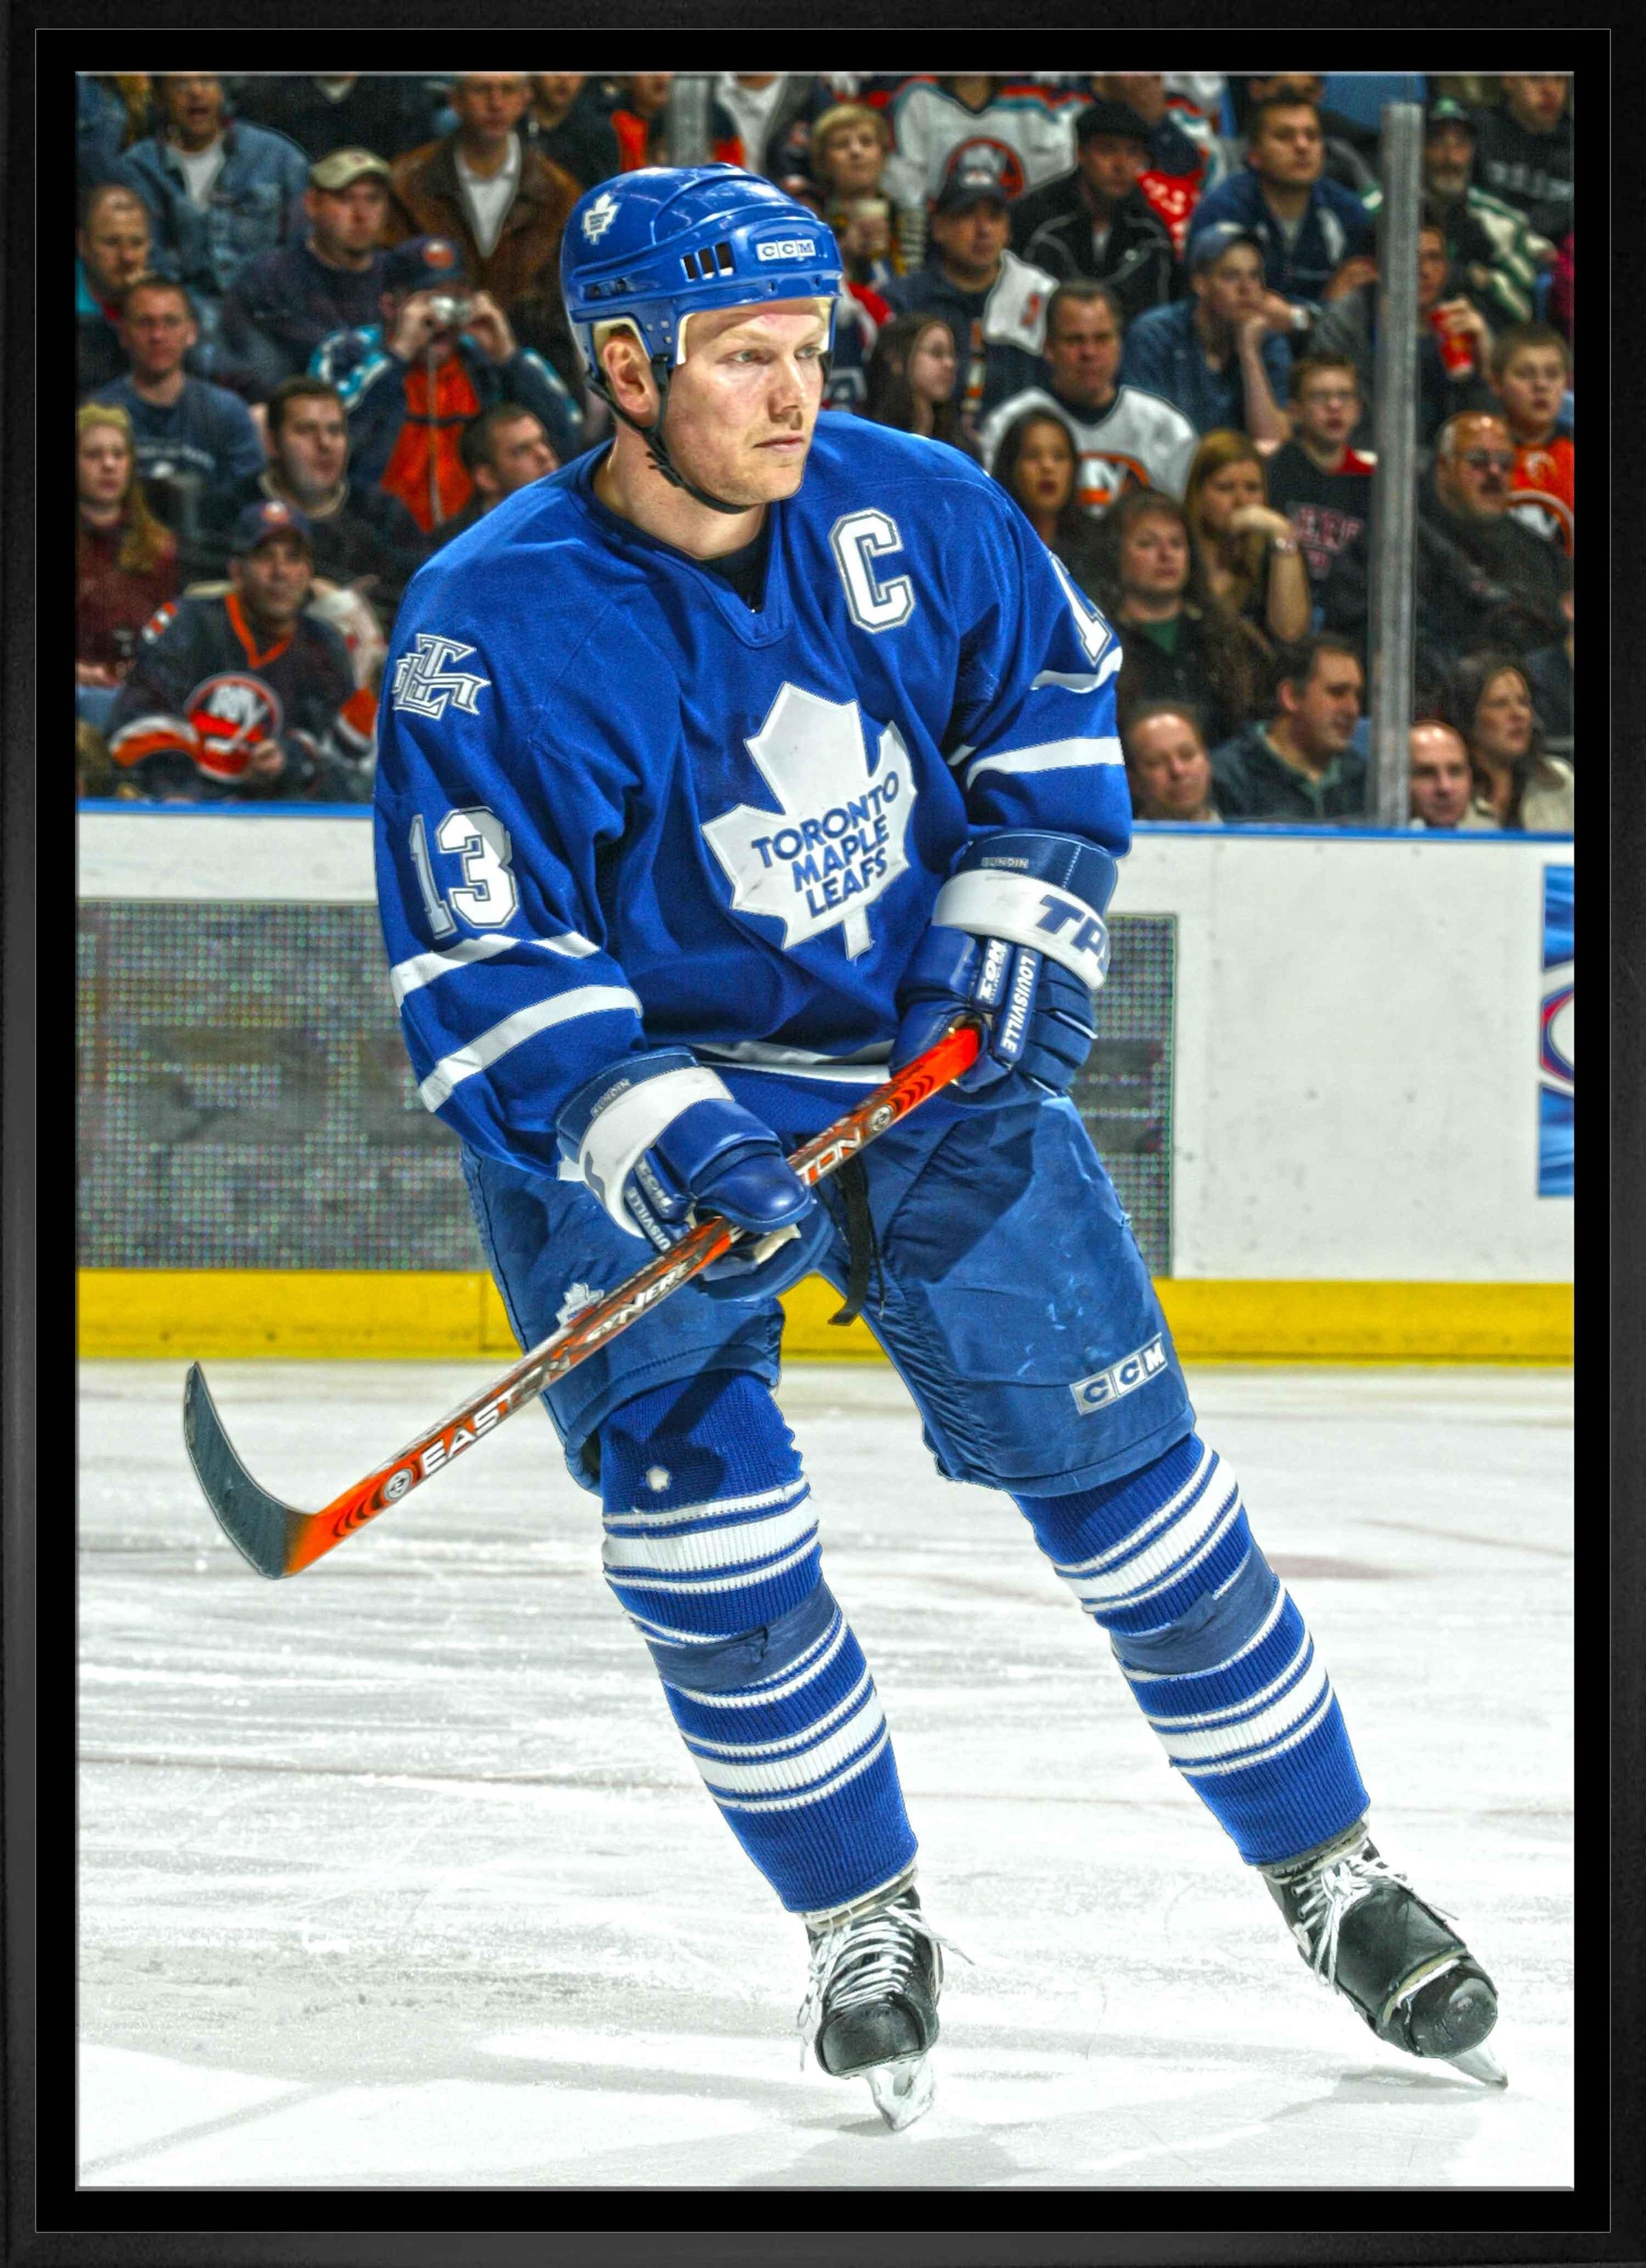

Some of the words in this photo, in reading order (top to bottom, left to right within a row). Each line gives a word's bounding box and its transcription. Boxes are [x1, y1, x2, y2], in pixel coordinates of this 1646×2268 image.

[760, 241, 815, 259] CCM
[829, 508, 915, 633] C
[751, 771, 900, 869] TORONTO
[791, 814, 890, 893] MAPLE
[409, 805, 519, 940] 13
[806, 847, 887, 919] LEAFS
[1000, 955, 1036, 1053] LOUISVILLE
[795, 1127, 862, 1186] TON
[626, 1186, 672, 1252] UISVILLE
[1080, 1338, 1166, 1406] CCM
